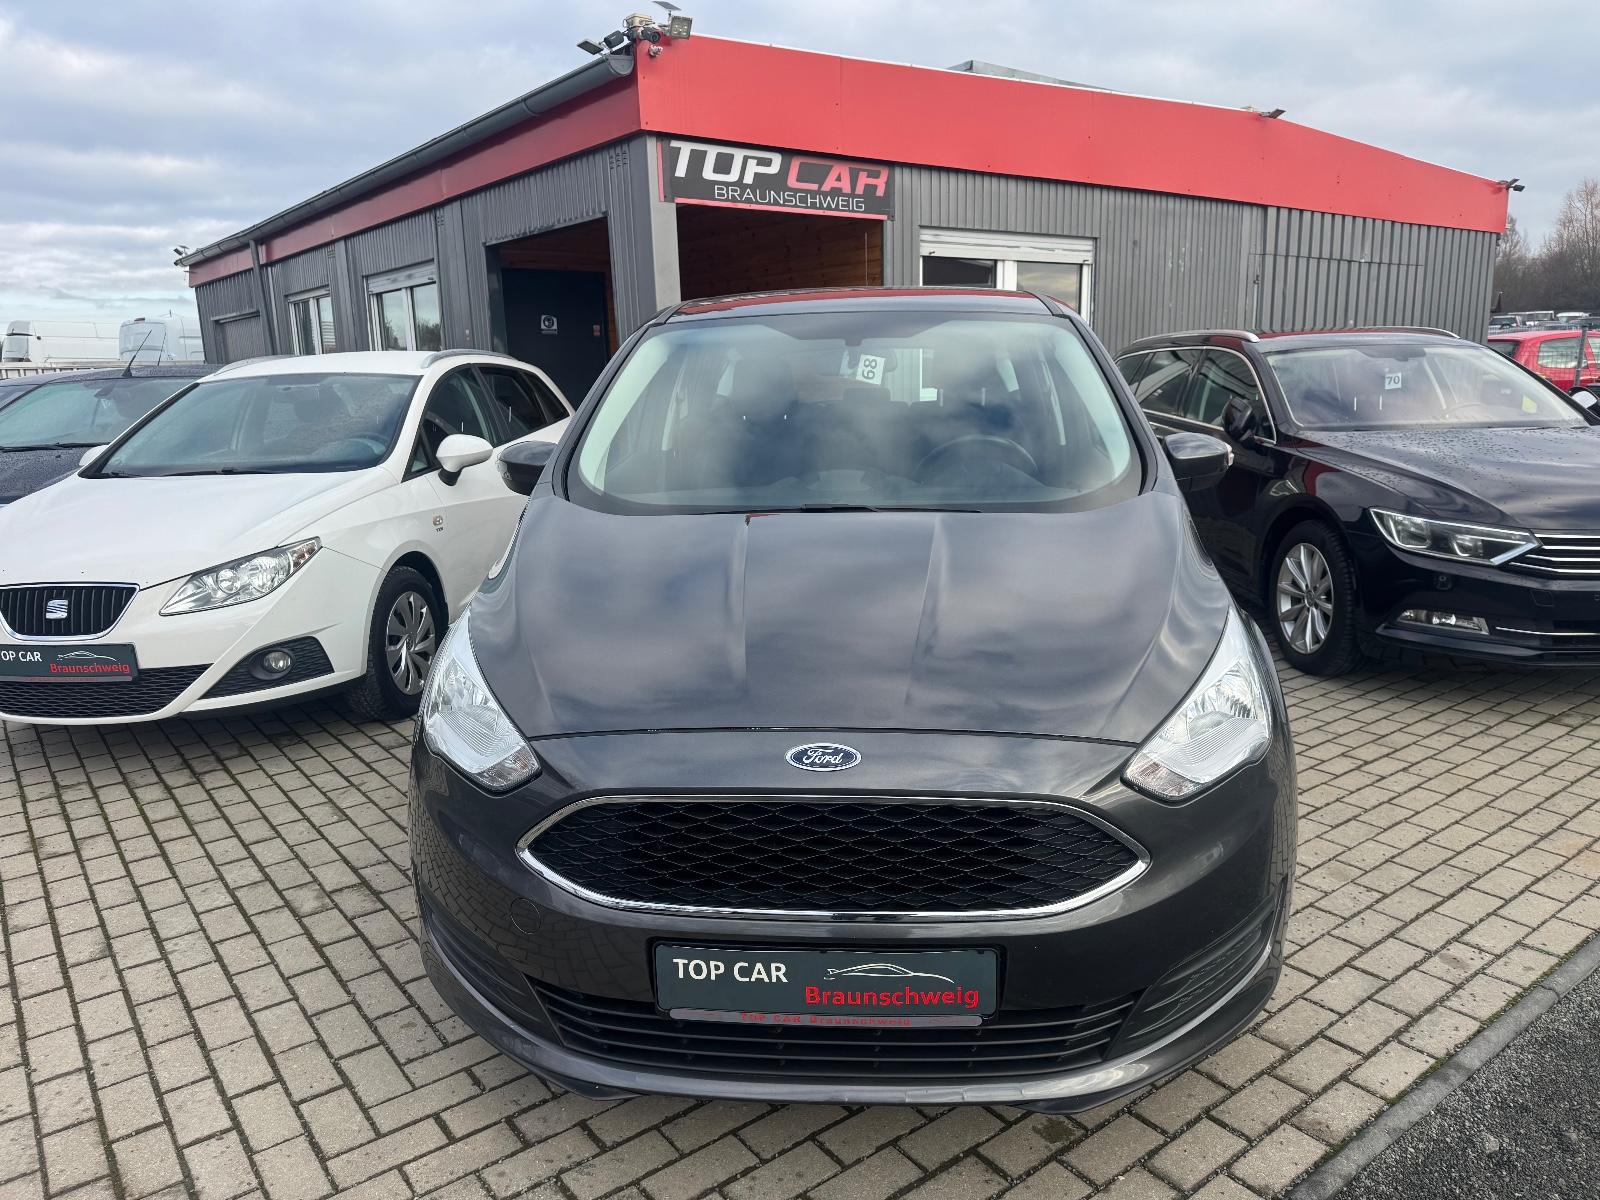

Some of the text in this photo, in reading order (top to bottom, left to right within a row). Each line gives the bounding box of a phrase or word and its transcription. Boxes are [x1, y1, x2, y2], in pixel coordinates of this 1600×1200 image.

[670, 140, 889, 197] TOP CAR
[714, 184, 865, 212] BRAUNSCHWEIG
[1385, 375, 1400, 385] 70
[0, 650, 43, 662] OP CAR
[50, 662, 130, 673] Braunschweig
[802, 748, 844, 764] Ford
[673, 957, 789, 984] TOP CAR
[804, 985, 980, 1009] Braunschweig
